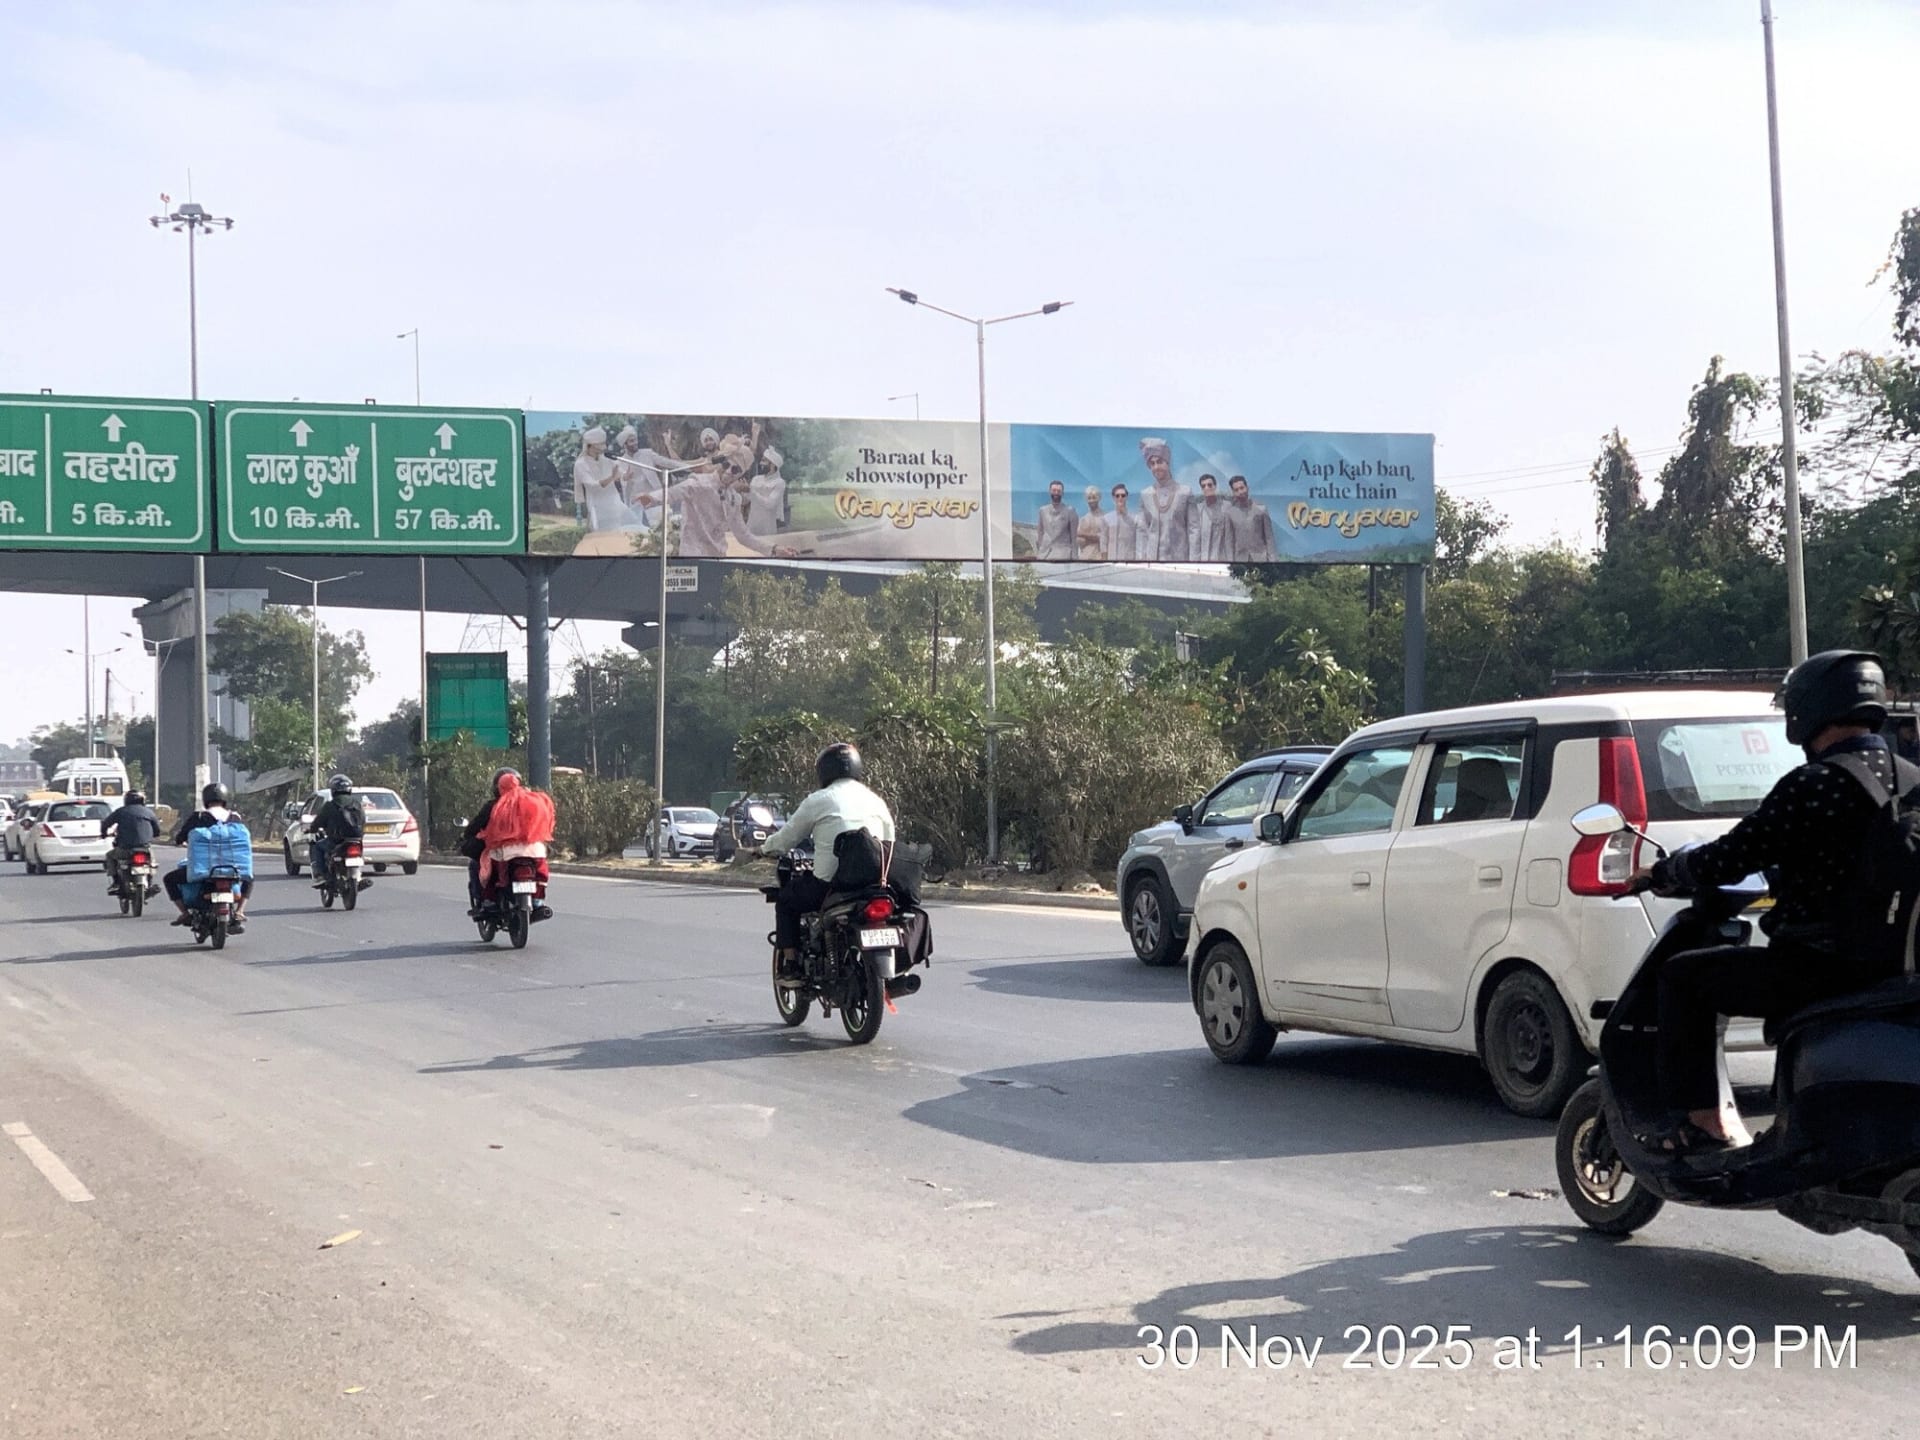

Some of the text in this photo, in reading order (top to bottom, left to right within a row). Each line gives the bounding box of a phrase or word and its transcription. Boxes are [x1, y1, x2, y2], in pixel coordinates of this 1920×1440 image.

[63, 441, 179, 483] तहसील
[859, 448, 926, 466] Baraat
[246, 454, 299, 485] लाल
[394, 447, 498, 501] बुलंदशहर
[845, 466, 968, 489] showstopper
[1290, 458, 1415, 482] Aap kab ban
[1309, 483, 1397, 500] rahe hain
[72, 503, 87, 525] 5
[250, 507, 278, 528] 10
[395, 508, 423, 530] 57
[834, 489, 980, 529] Manyavar
[1286, 501, 1420, 538] Manyavar
